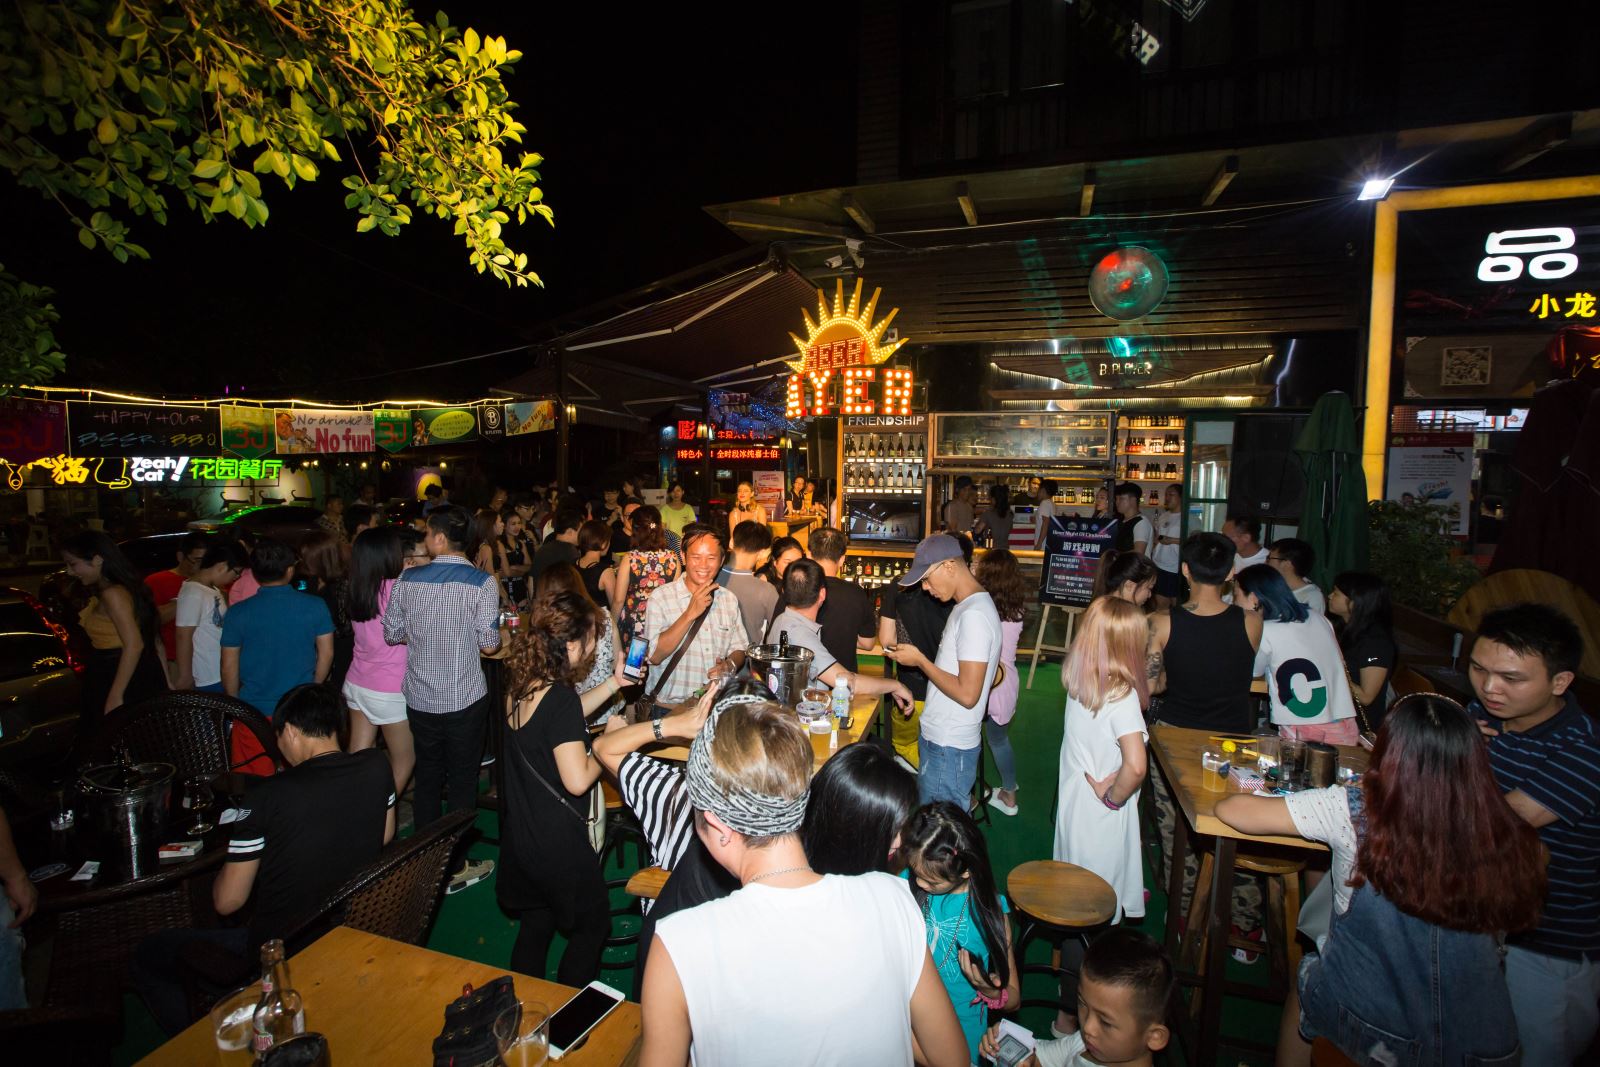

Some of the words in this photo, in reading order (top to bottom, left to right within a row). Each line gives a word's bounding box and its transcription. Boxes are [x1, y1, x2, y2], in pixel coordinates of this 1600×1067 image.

[1477, 226, 1578, 282] 品
[1528, 292, 1597, 319] 小龙
[805, 336, 863, 372] BEER
[93, 409, 151, 425] HAPPY
[156, 410, 202, 426] HOUR
[297, 415, 316, 426] No
[319, 414, 362, 426] drink?
[848, 416, 925, 426] FRIENDSHIP
[315, 428, 340, 453] No
[343, 427, 375, 453] fun!
[131, 457, 176, 470] Yeah
[190, 458, 284, 481] 花园餐厅
[131, 468, 165, 482] Cat
[1062, 541, 1101, 554] 游戏规则
[1276, 657, 1327, 719] C
